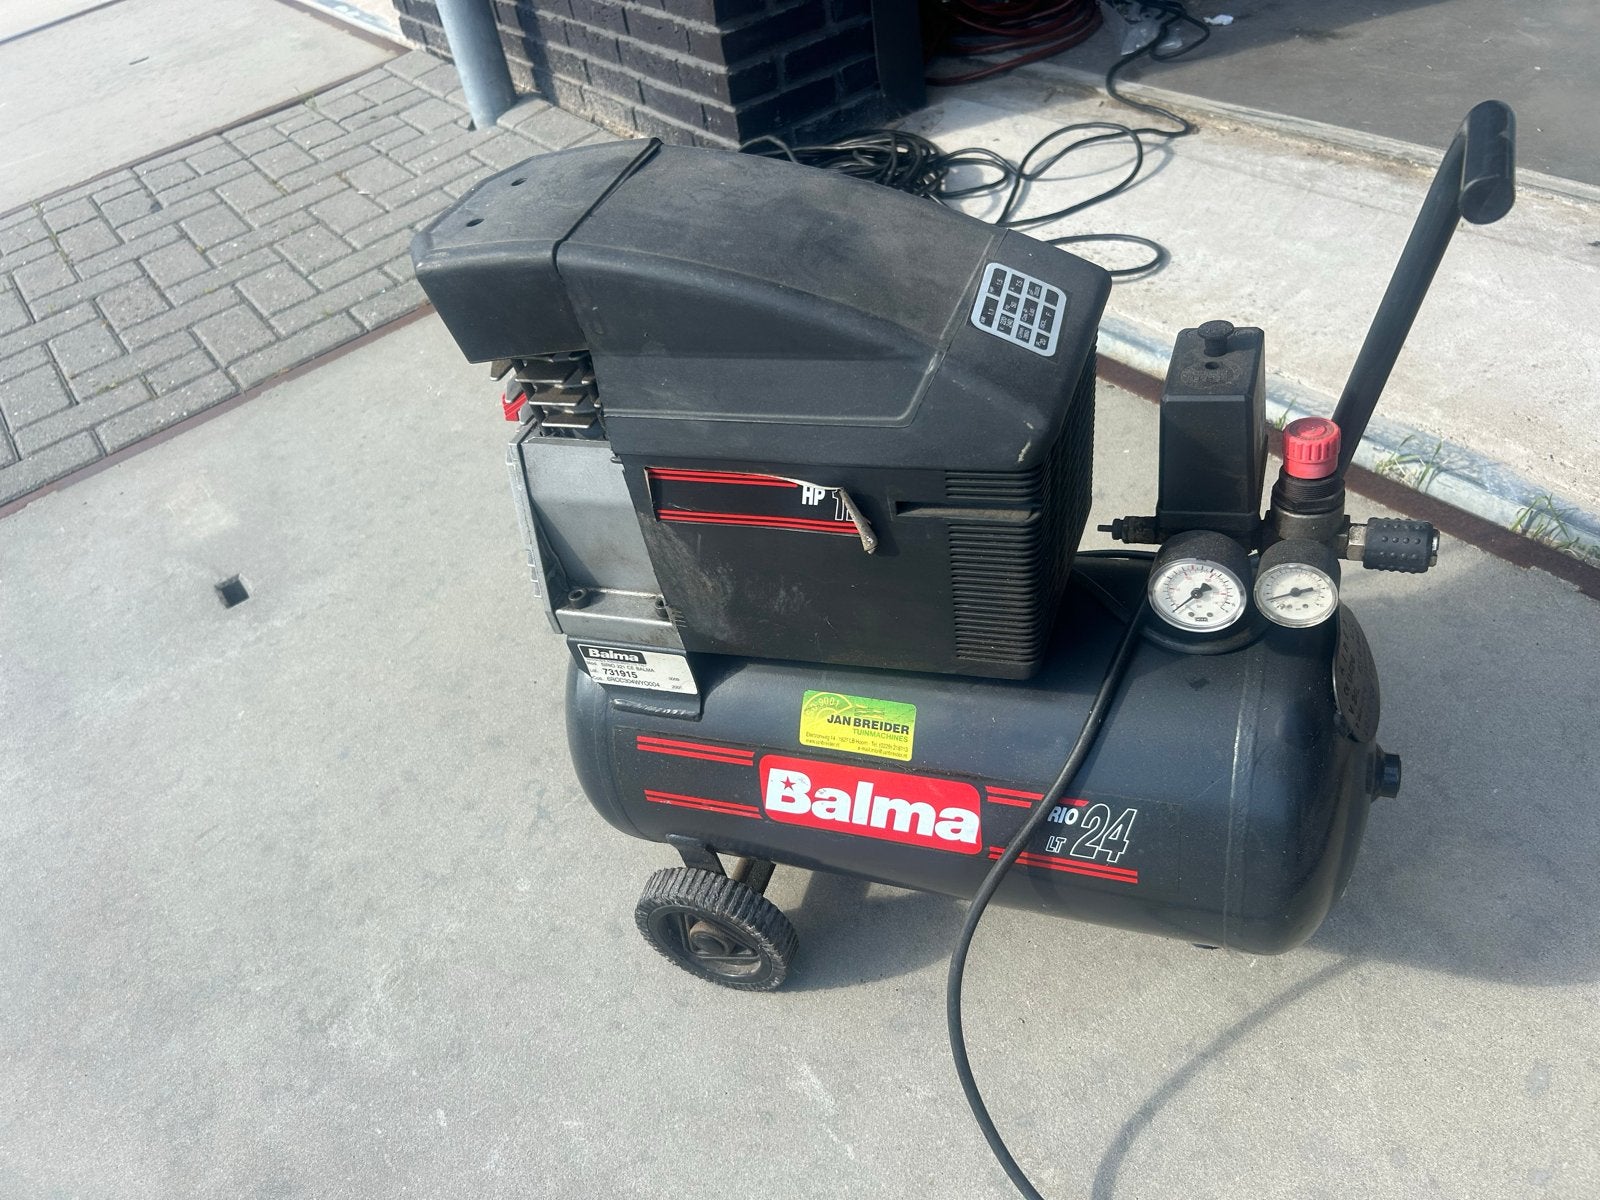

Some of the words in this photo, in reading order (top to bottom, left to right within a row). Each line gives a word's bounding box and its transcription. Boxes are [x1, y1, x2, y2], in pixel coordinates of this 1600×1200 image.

[802, 486, 825, 505] HP
[588, 648, 639, 662] Balma
[602, 668, 638, 678] 731915
[827, 714, 851, 726] JAN
[853, 718, 909, 735] BREIDER
[853, 729, 908, 742] TUINMACHINES
[766, 768, 980, 844] Balma
[1047, 806, 1079, 825] RIO
[1070, 804, 1138, 863] 24
[1045, 836, 1067, 853] LT
